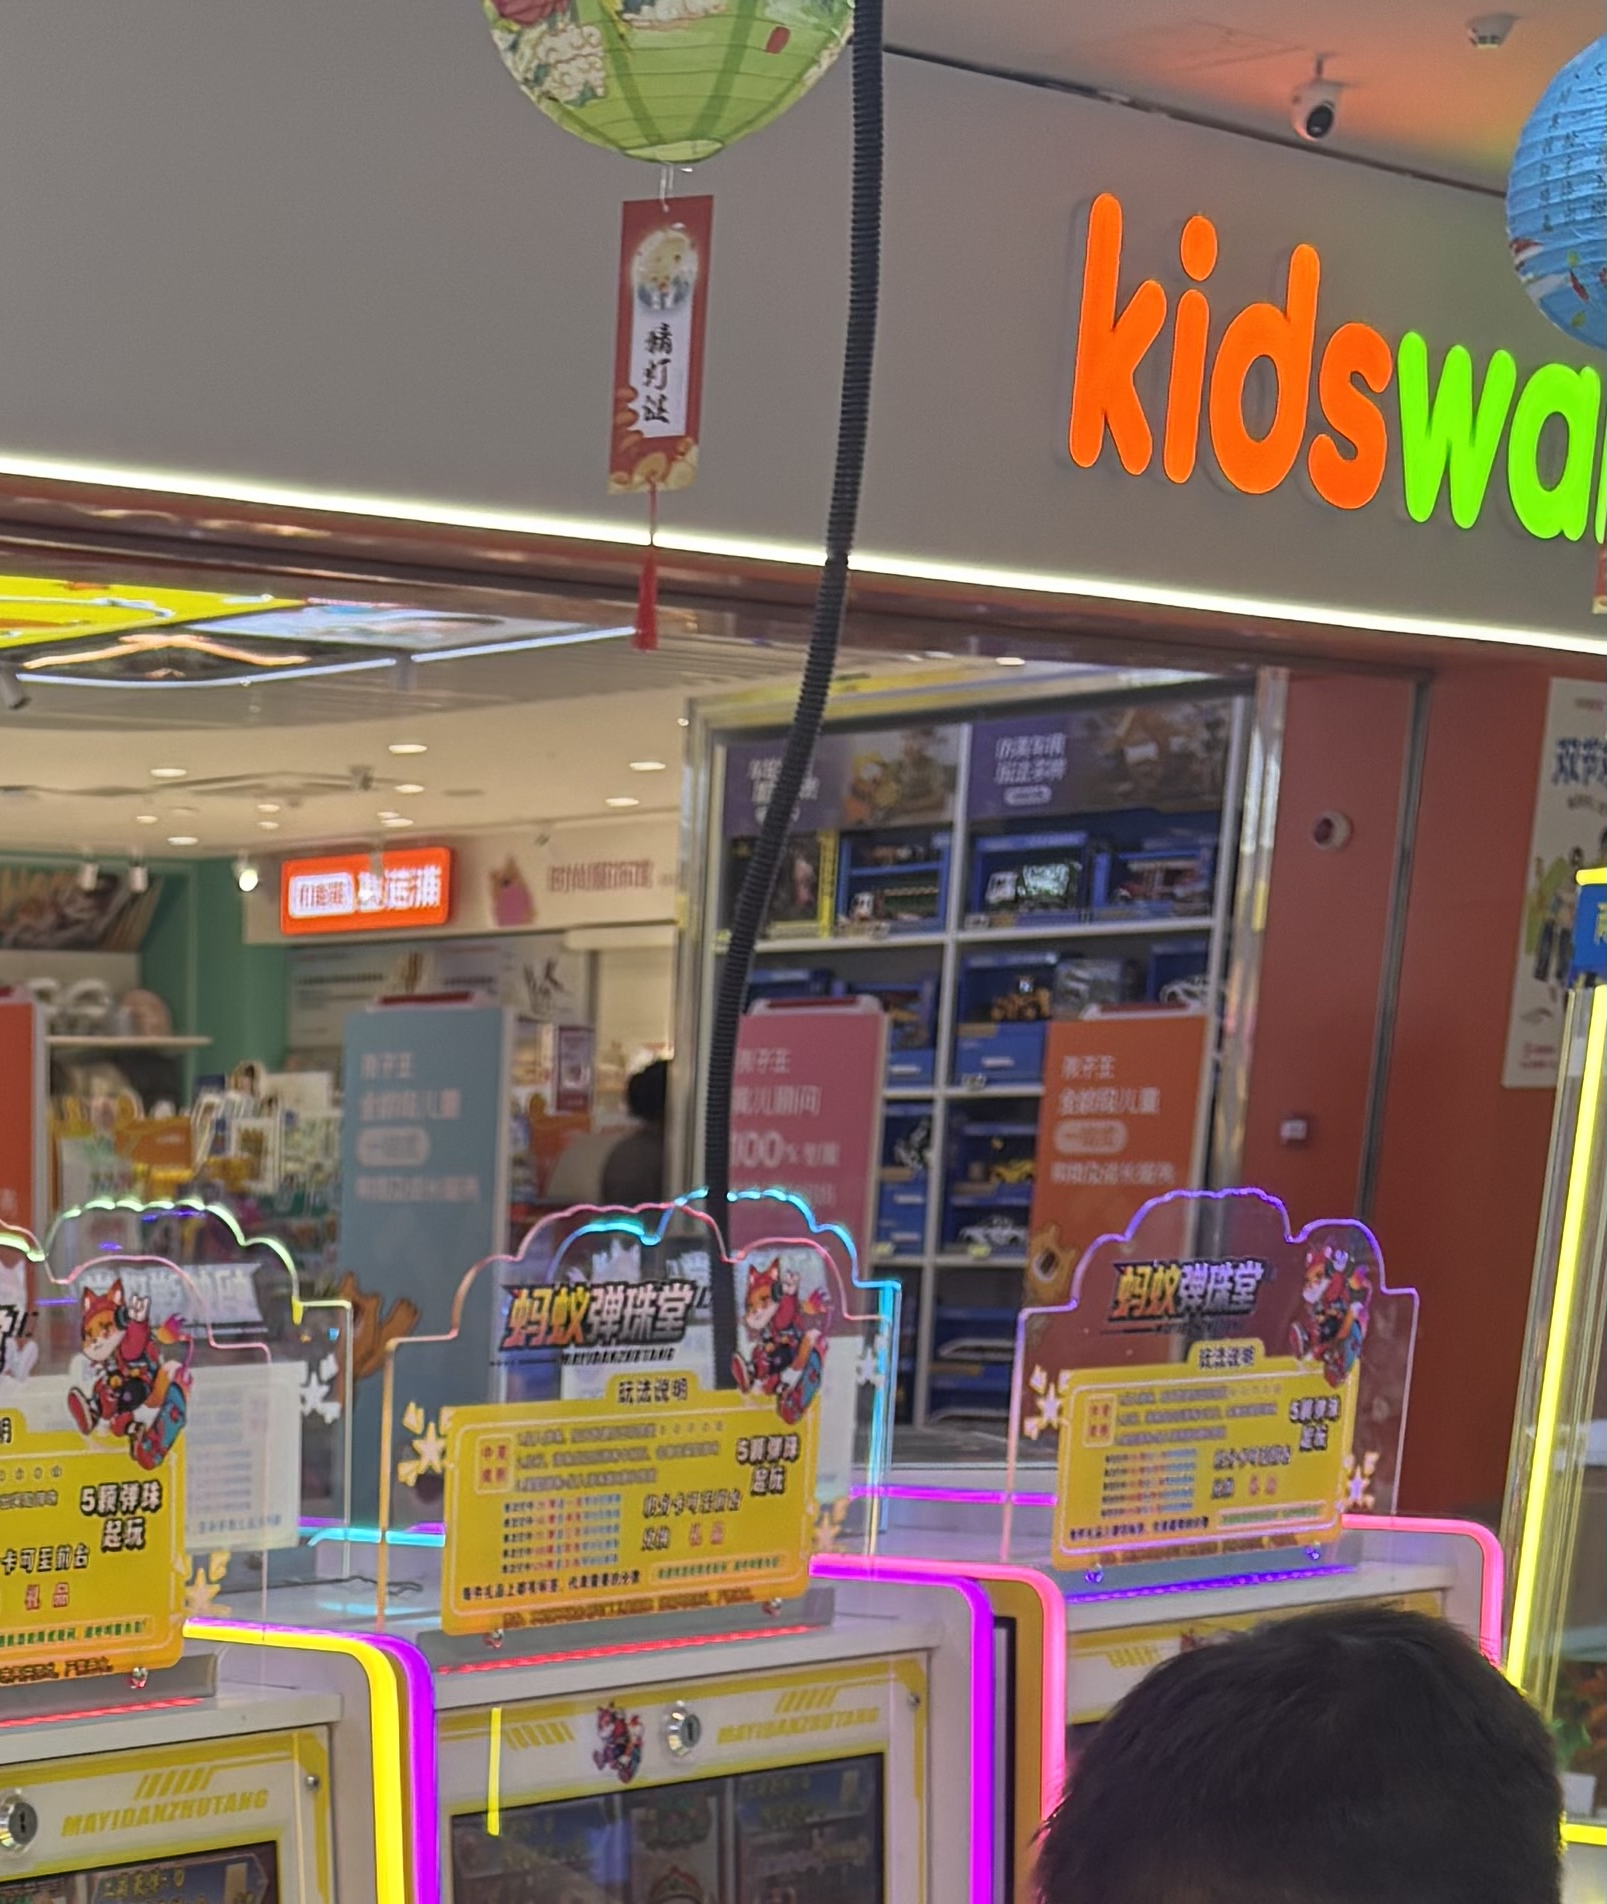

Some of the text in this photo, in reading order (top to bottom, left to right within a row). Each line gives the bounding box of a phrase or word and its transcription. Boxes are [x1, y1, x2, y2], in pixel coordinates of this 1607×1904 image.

[1069, 193, 1607, 542] kidswa
[502, 1282, 694, 1348] 蚂蚁弹珠堂
[80, 1479, 163, 1517] 5颗弹珠
[101, 1516, 146, 1553] 起玩
